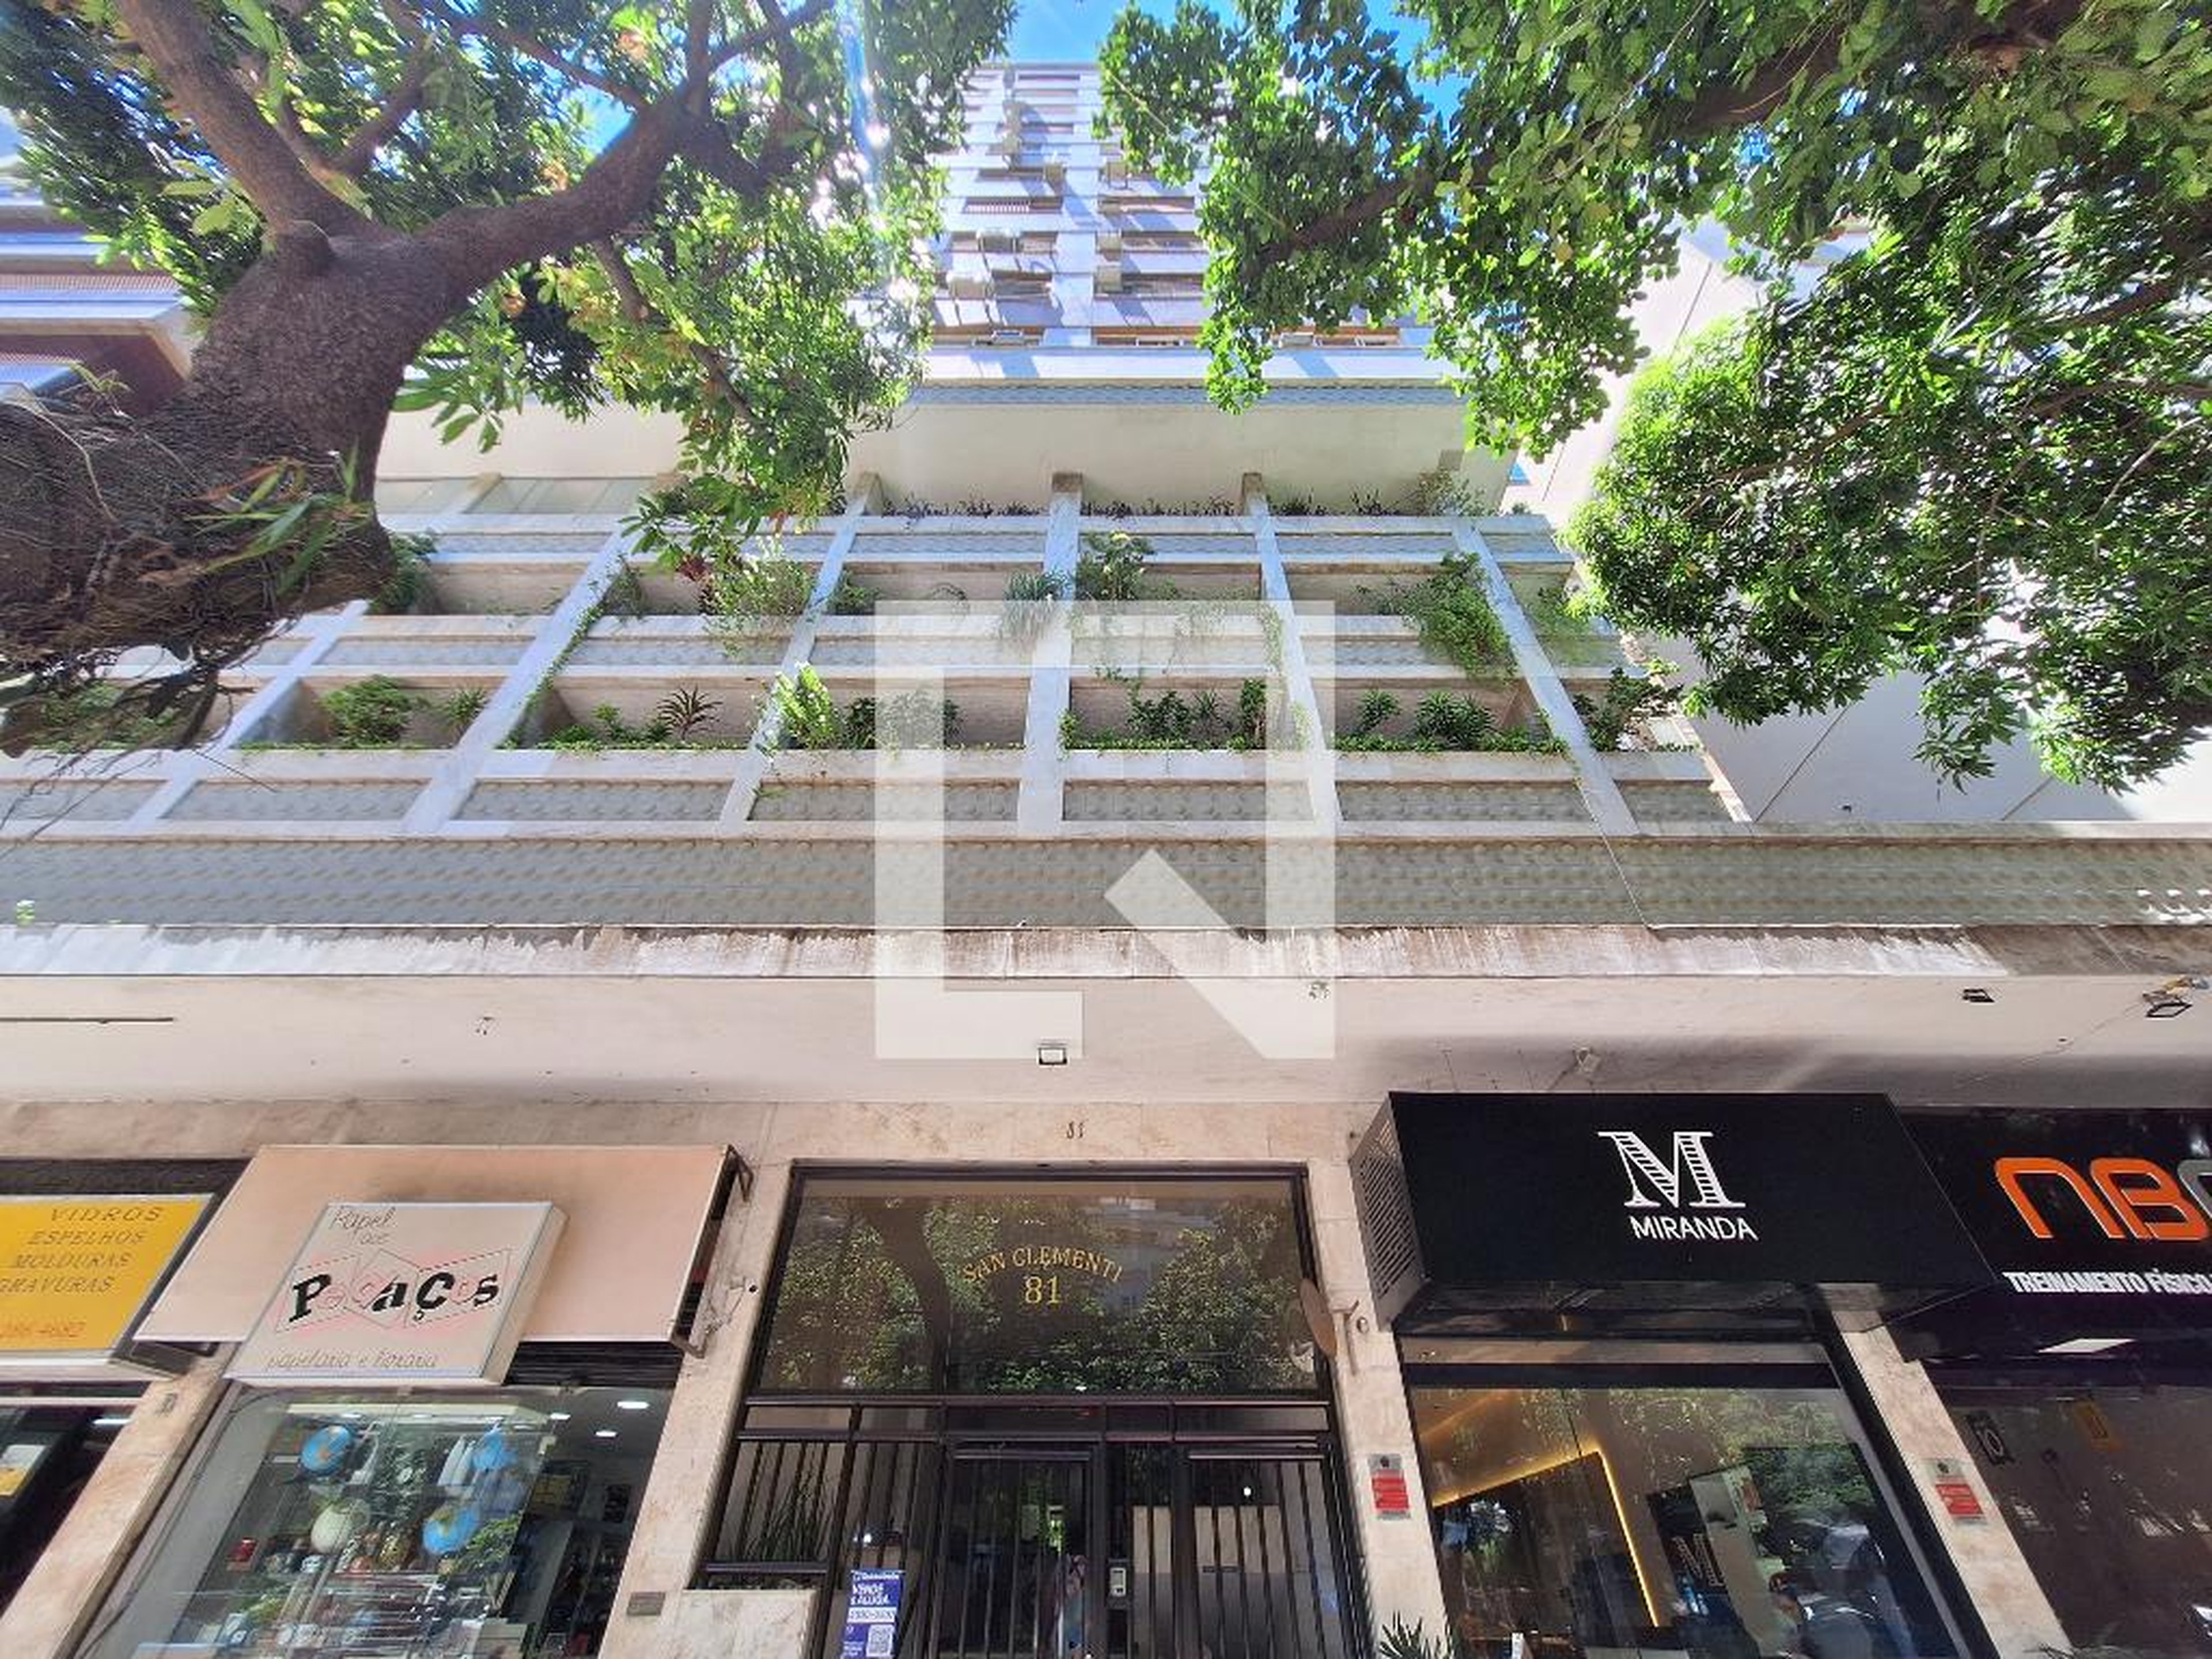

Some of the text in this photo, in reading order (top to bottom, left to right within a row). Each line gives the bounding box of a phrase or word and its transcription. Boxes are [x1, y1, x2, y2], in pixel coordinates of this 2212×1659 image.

[50, 1206, 164, 1222] VIDROS
[27, 1230, 146, 1245] ESPELHOS
[1630, 1215, 1759, 1241] MIRANDA
[14, 1251, 132, 1269] MOLDURAS
[962, 1252, 1007, 1282] SAN
[1024, 1275, 1062, 1306] 81
[2002, 1271, 2149, 1293] TREINAMENTO
